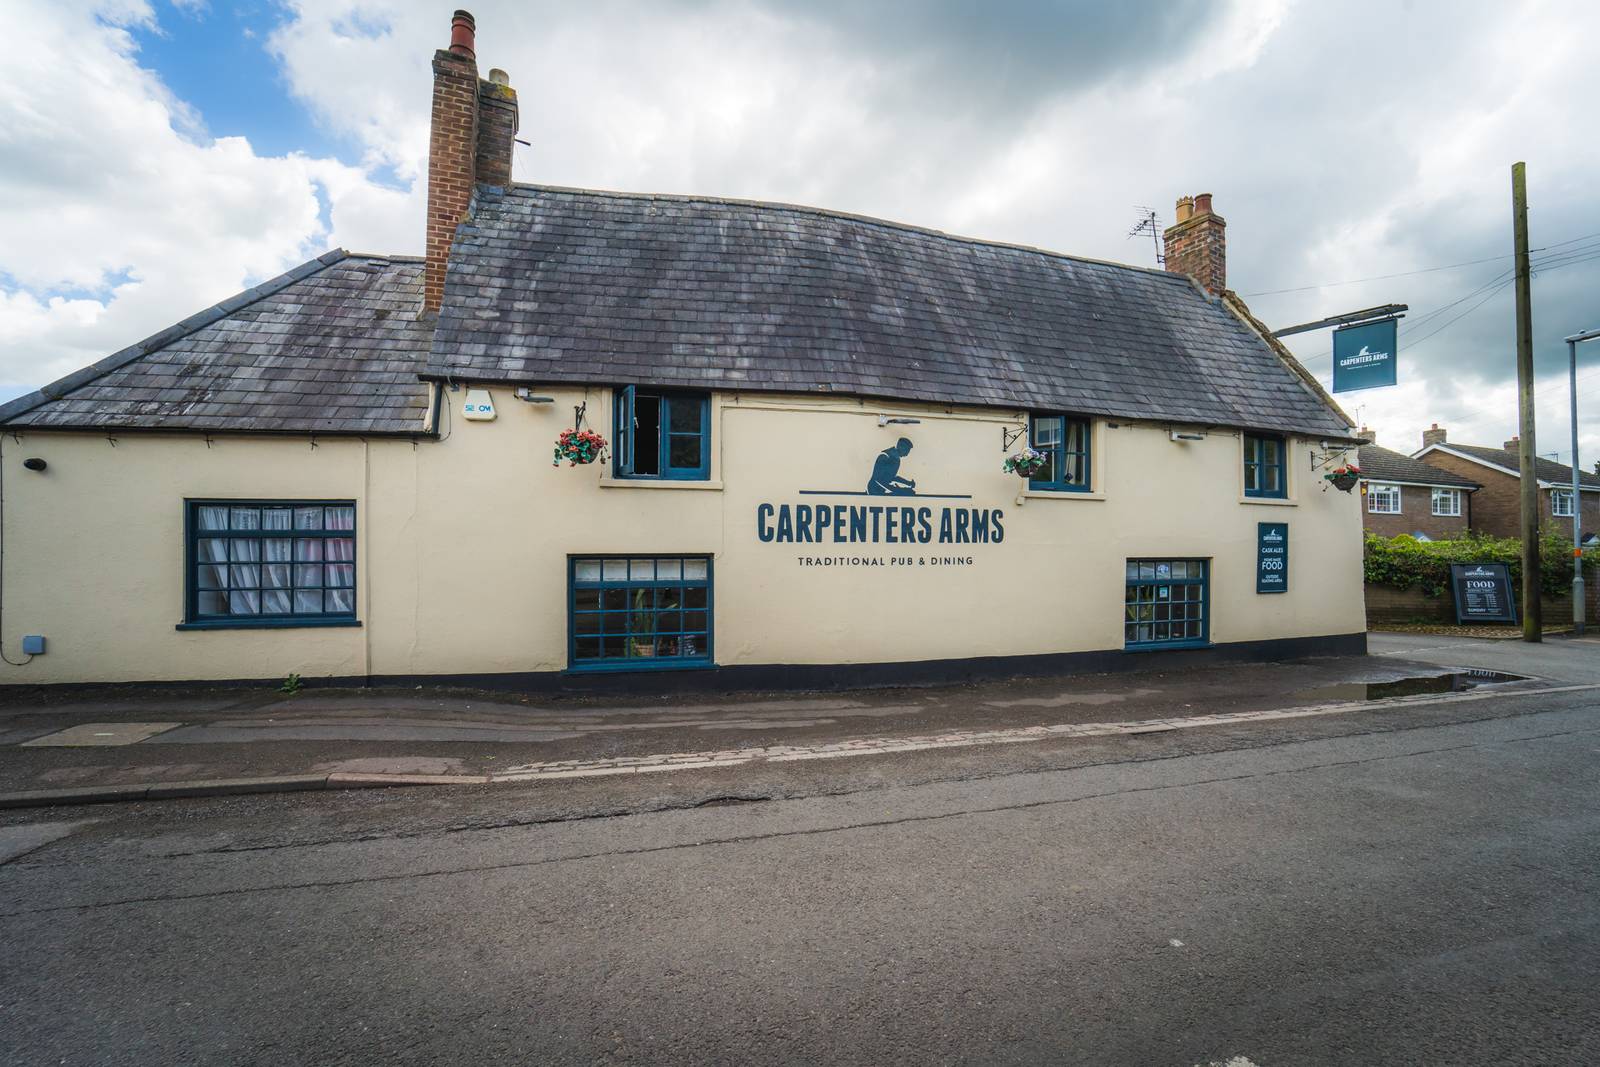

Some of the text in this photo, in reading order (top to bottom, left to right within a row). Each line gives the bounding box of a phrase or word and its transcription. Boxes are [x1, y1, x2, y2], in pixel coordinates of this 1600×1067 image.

[1340, 355, 1372, 366] CARPENTERS
[757, 503, 1005, 543] CARPENTERS ARMS
[798, 556, 973, 566] TRADITIONAL PUB & DINING
[1262, 562, 1283, 570] FOOD
